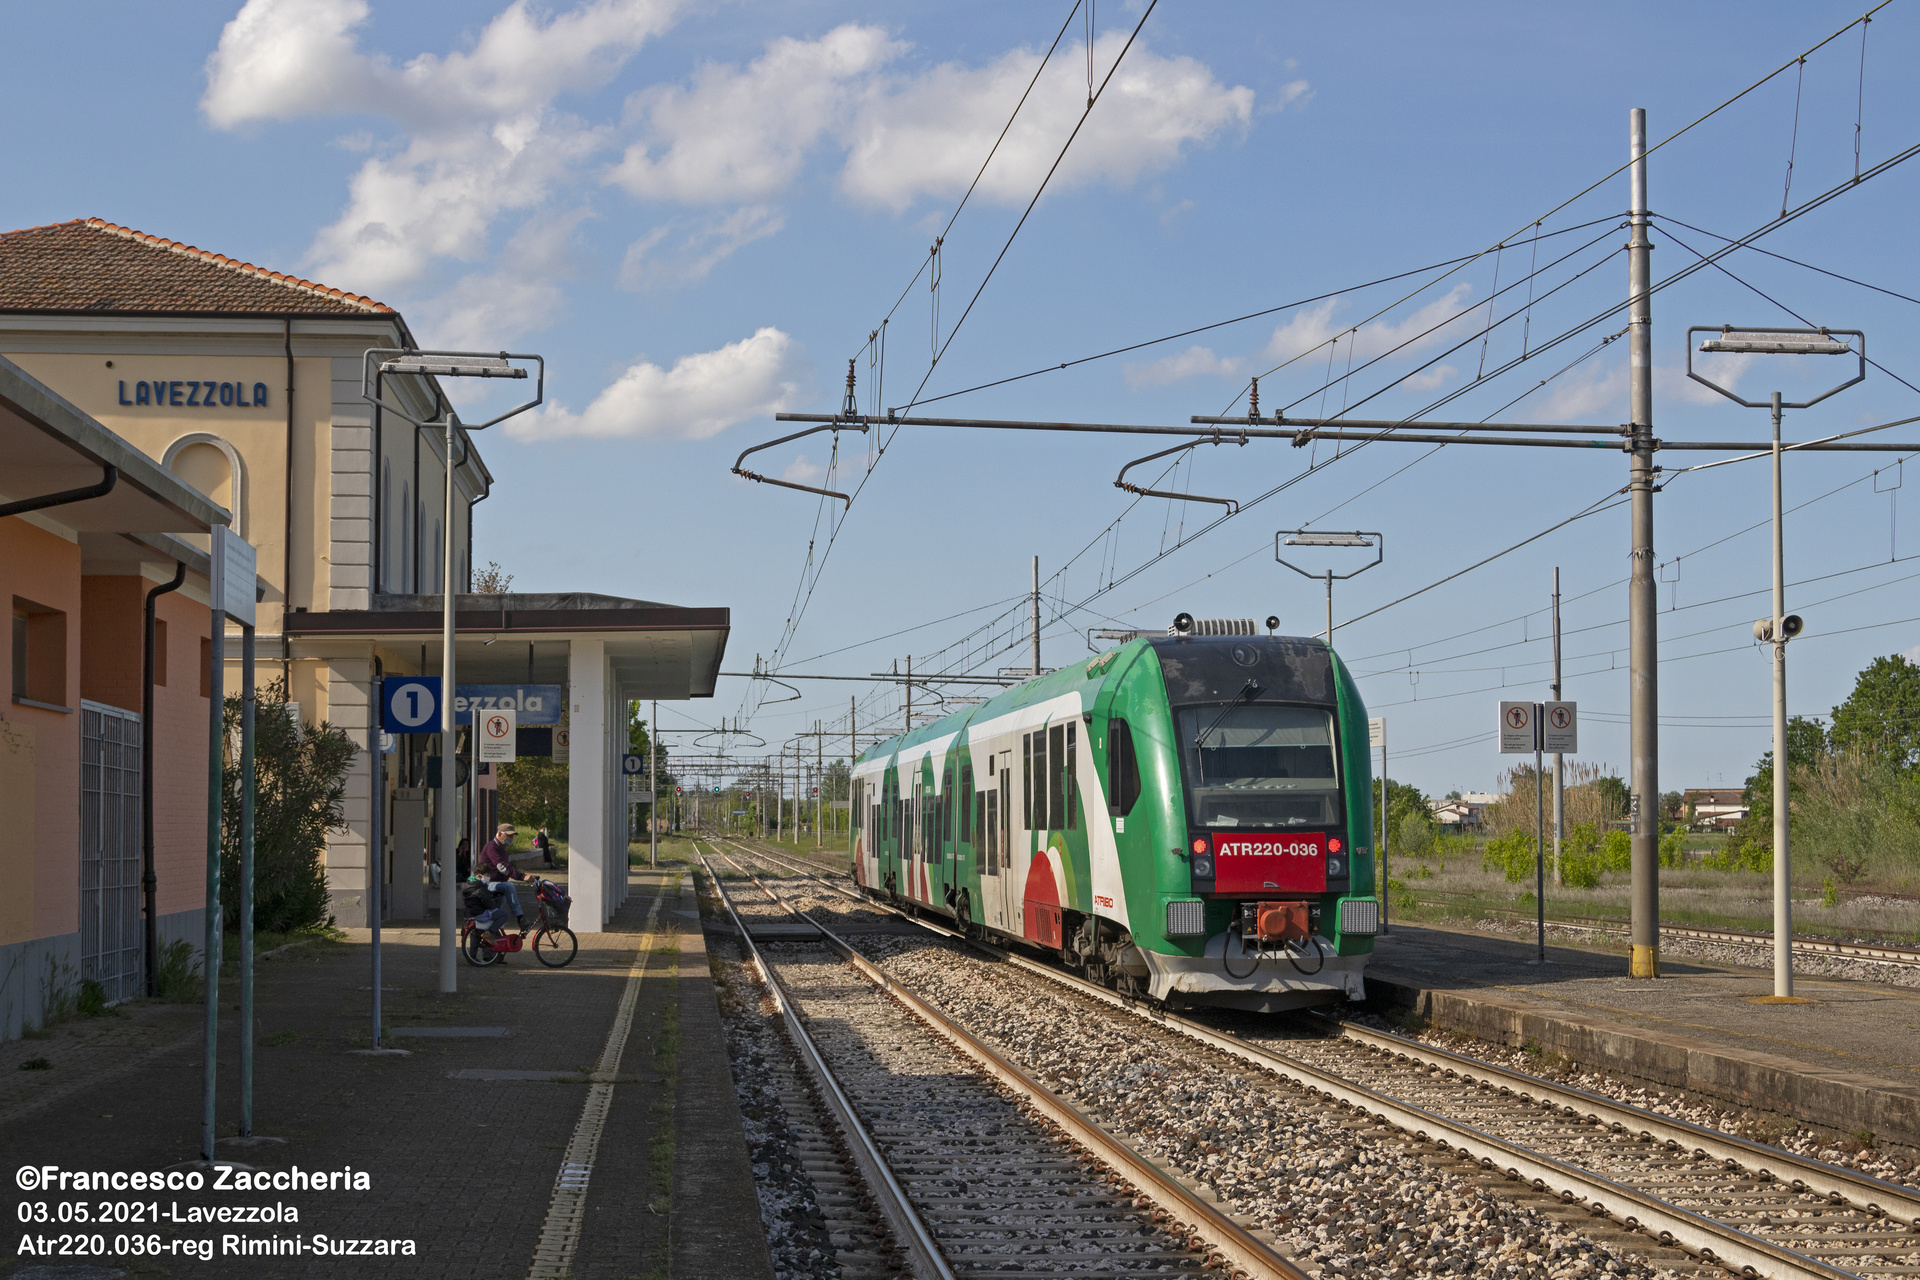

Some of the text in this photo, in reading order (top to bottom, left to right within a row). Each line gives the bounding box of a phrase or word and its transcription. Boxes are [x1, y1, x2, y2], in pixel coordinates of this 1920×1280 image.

[118, 380, 268, 407] LAVEZZOLA
[406, 691, 419, 719] 1
[455, 689, 542, 712] ezzola
[630, 759, 635, 770] 1
[1219, 843, 1318, 856] ATR220-036
